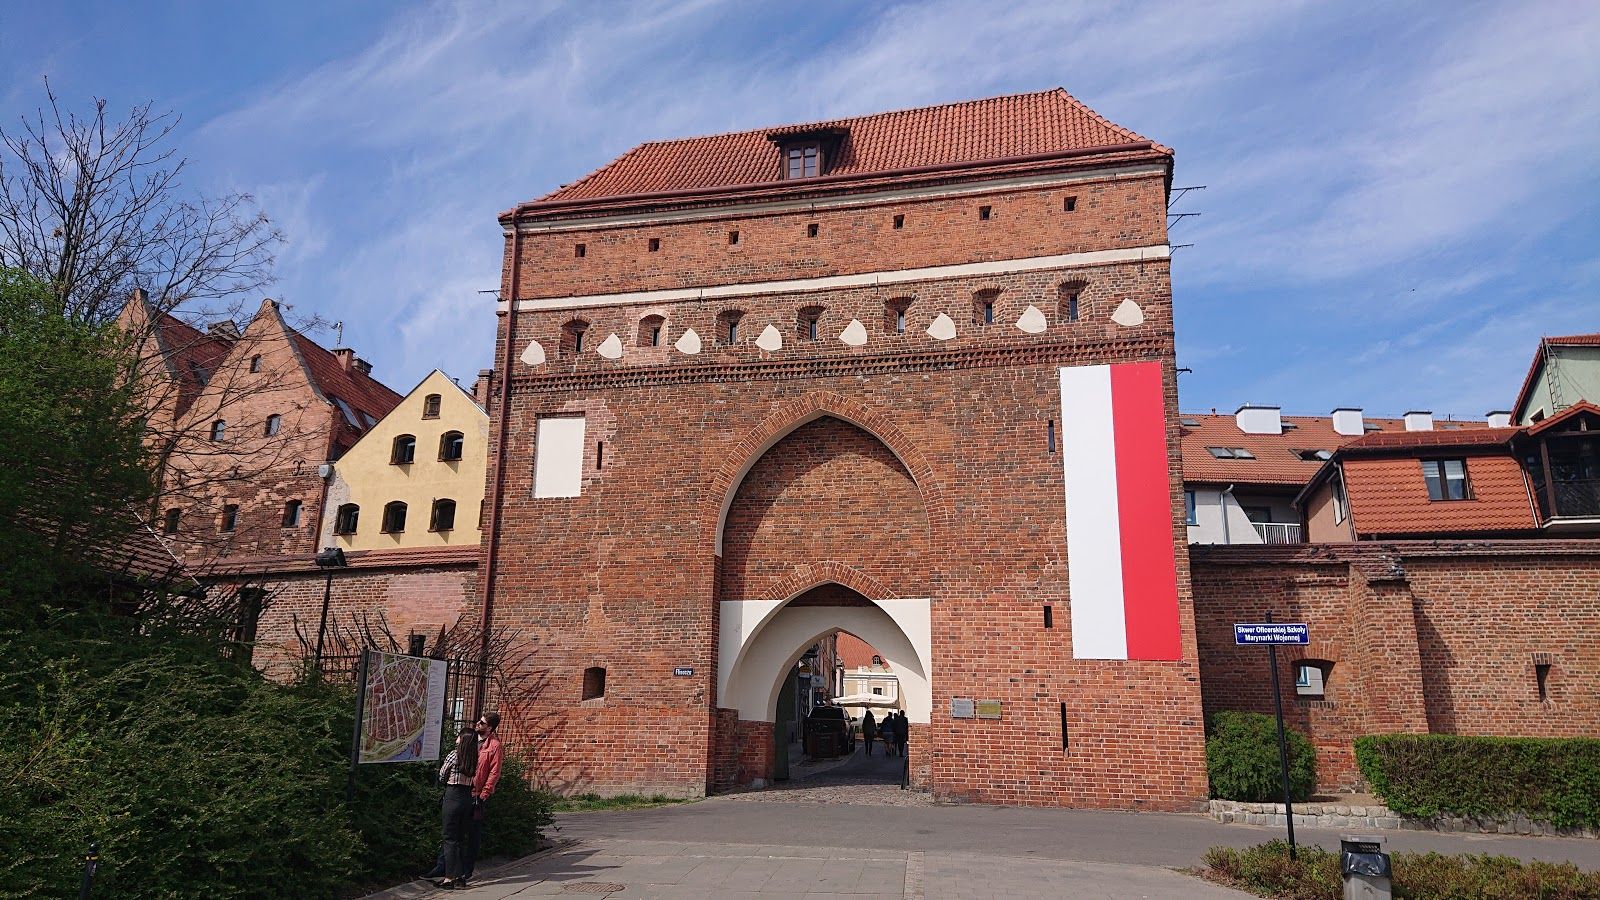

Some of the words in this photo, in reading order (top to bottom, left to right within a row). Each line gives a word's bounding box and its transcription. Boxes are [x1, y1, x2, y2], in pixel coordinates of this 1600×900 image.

[1256, 626, 1286, 634] Oficerskiej
[1245, 634, 1272, 642] Marynarki
[1274, 634, 1300, 642] Wojennej
